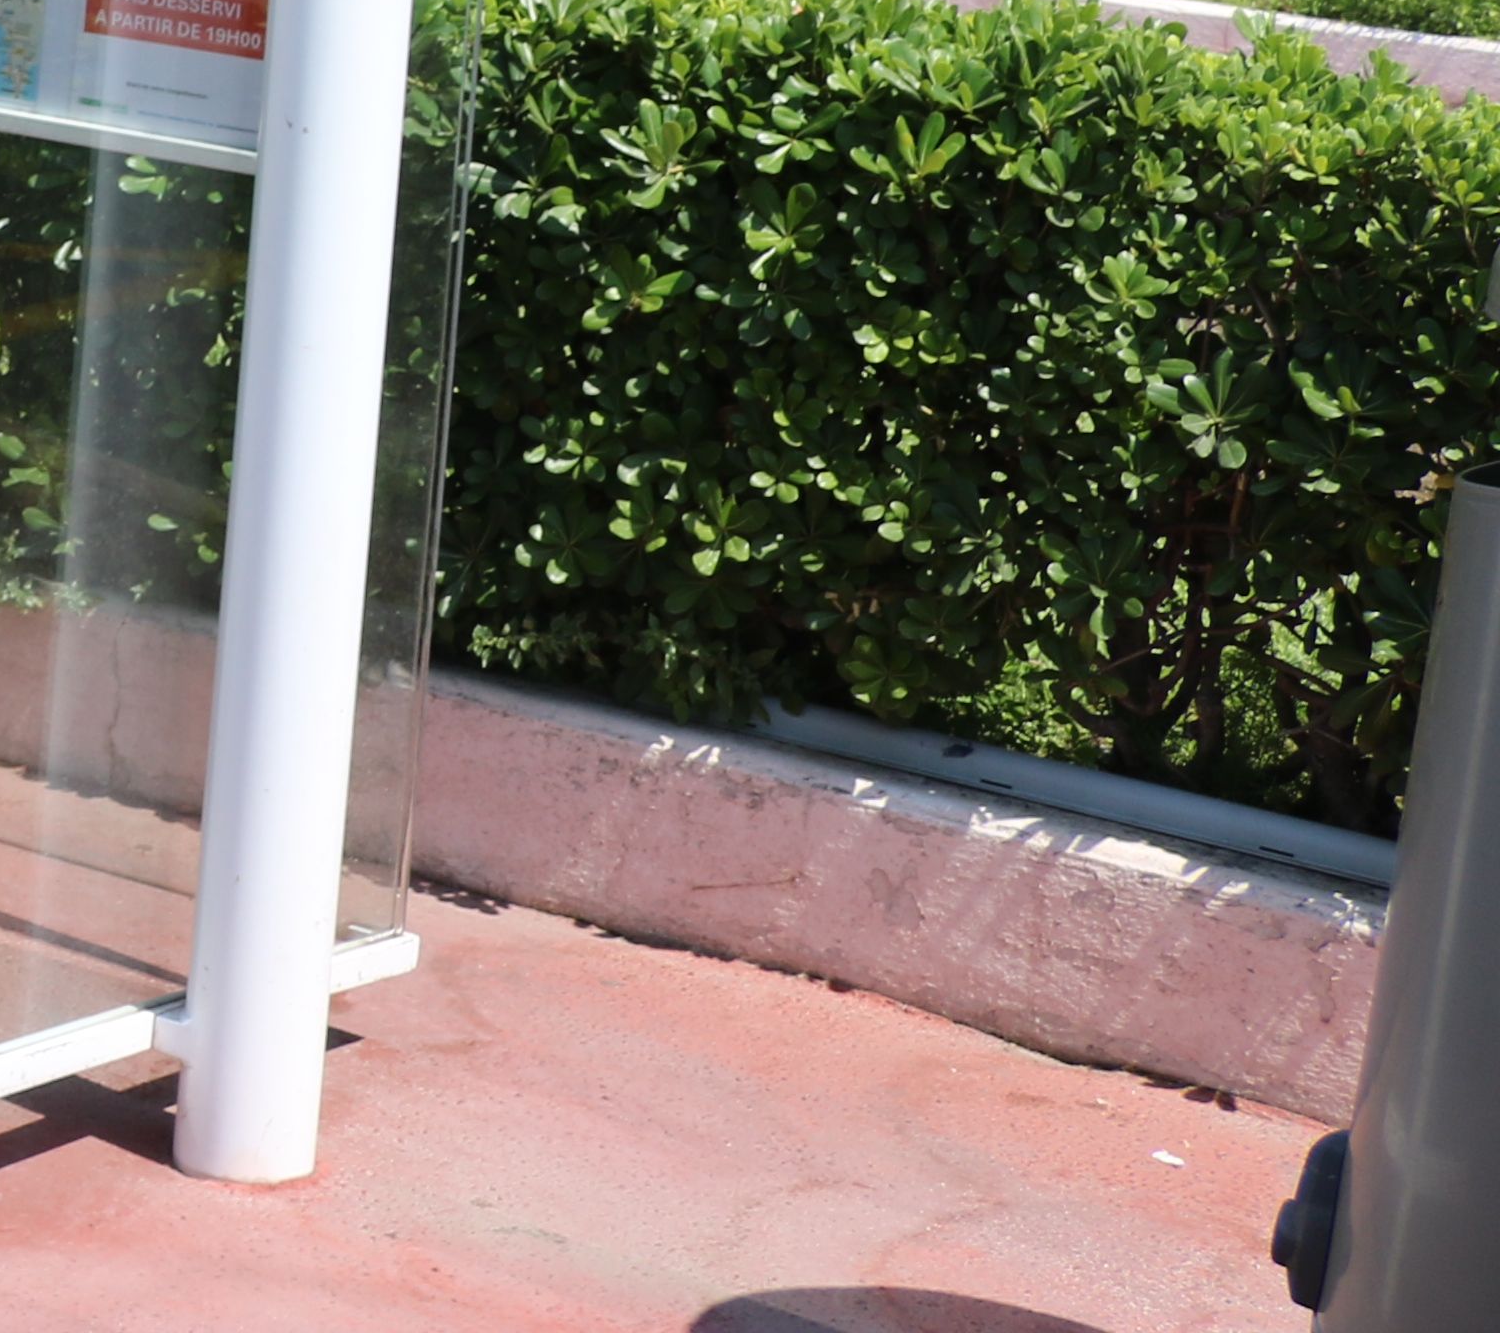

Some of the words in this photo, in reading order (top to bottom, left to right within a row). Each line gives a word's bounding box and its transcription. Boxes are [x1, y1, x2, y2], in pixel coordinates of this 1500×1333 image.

[95, 8, 107, 25] A
[112, 12, 173, 35] PARTIR
[177, 21, 201, 41] DE
[207, 27, 261, 50] 19H00
